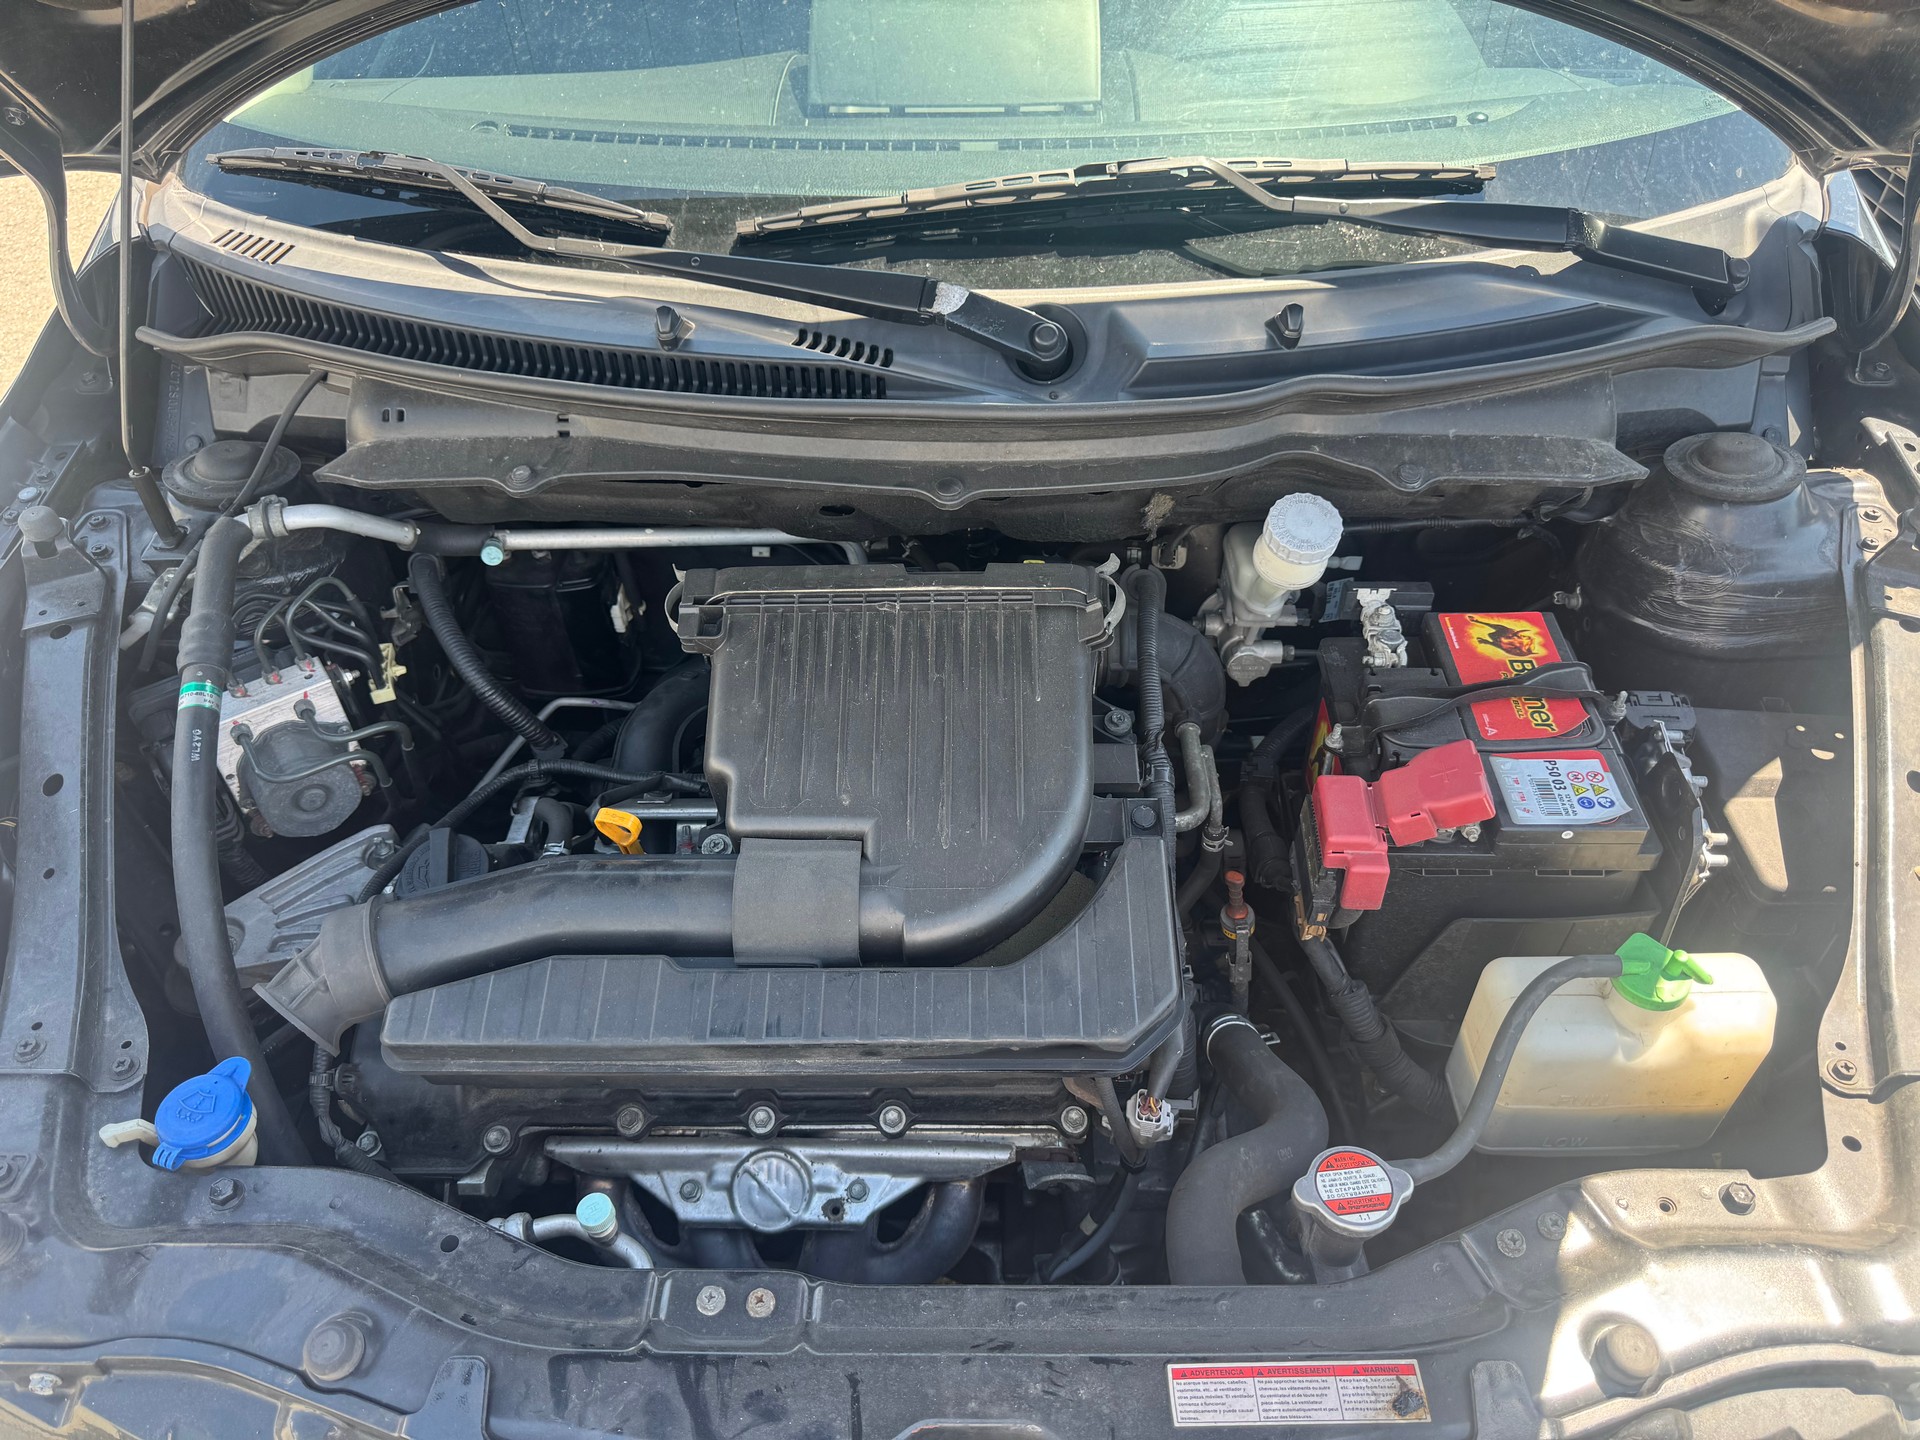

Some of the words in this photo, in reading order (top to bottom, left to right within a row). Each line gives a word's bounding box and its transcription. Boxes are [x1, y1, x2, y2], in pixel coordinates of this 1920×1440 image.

[1512, 700, 1524, 719] BULL
[1544, 760, 1562, 777] P50
[1552, 779, 1567, 791] 03
[1542, 1136, 1588, 1147] LOW
[1347, 1197, 1381, 1205] ADVERTENCIA
[1190, 1369, 1244, 1377] ADVERTENCIA
